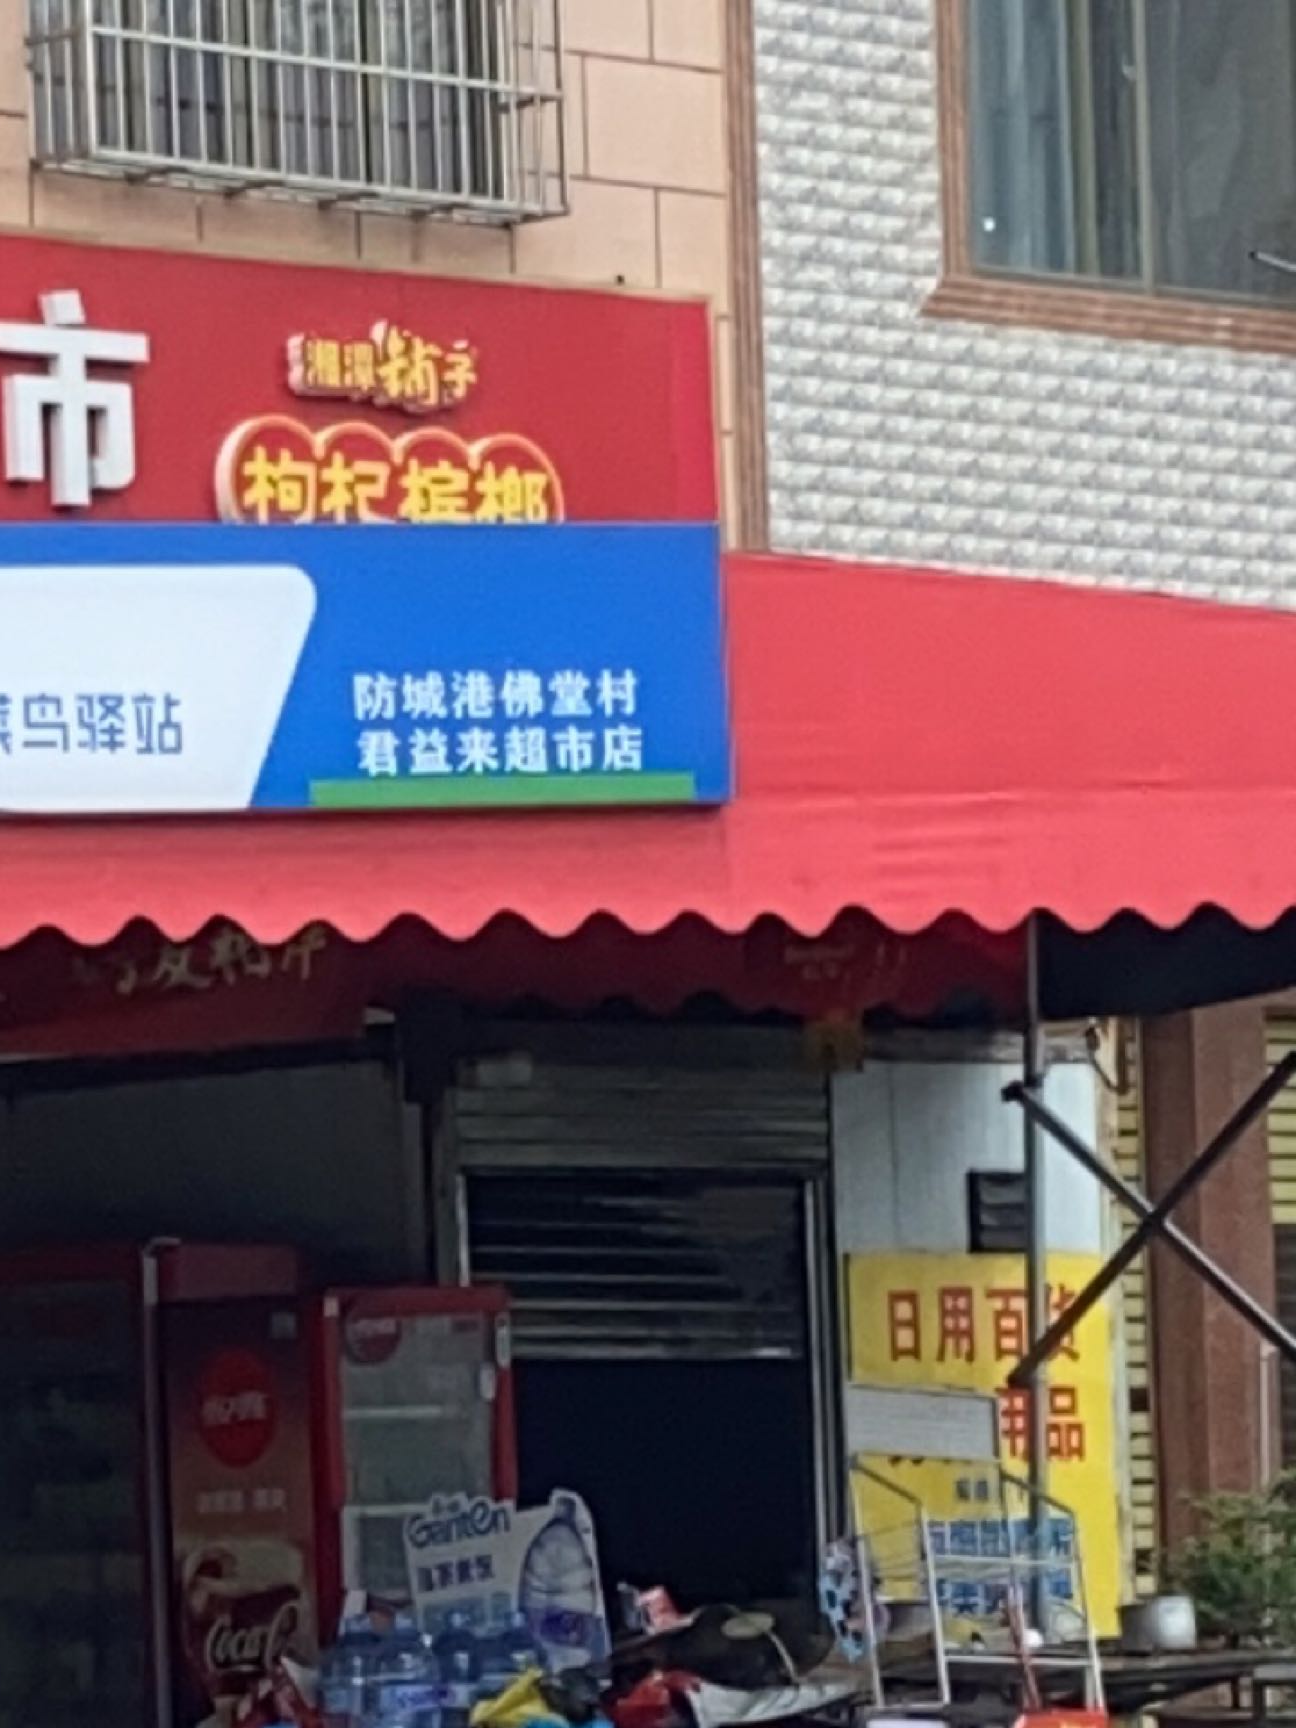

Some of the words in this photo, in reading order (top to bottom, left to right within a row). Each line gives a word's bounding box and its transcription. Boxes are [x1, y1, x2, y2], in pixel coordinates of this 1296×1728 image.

[353, 669, 638, 720] 防城港佛堂村
[358, 723, 643, 777] 君益来超市店
